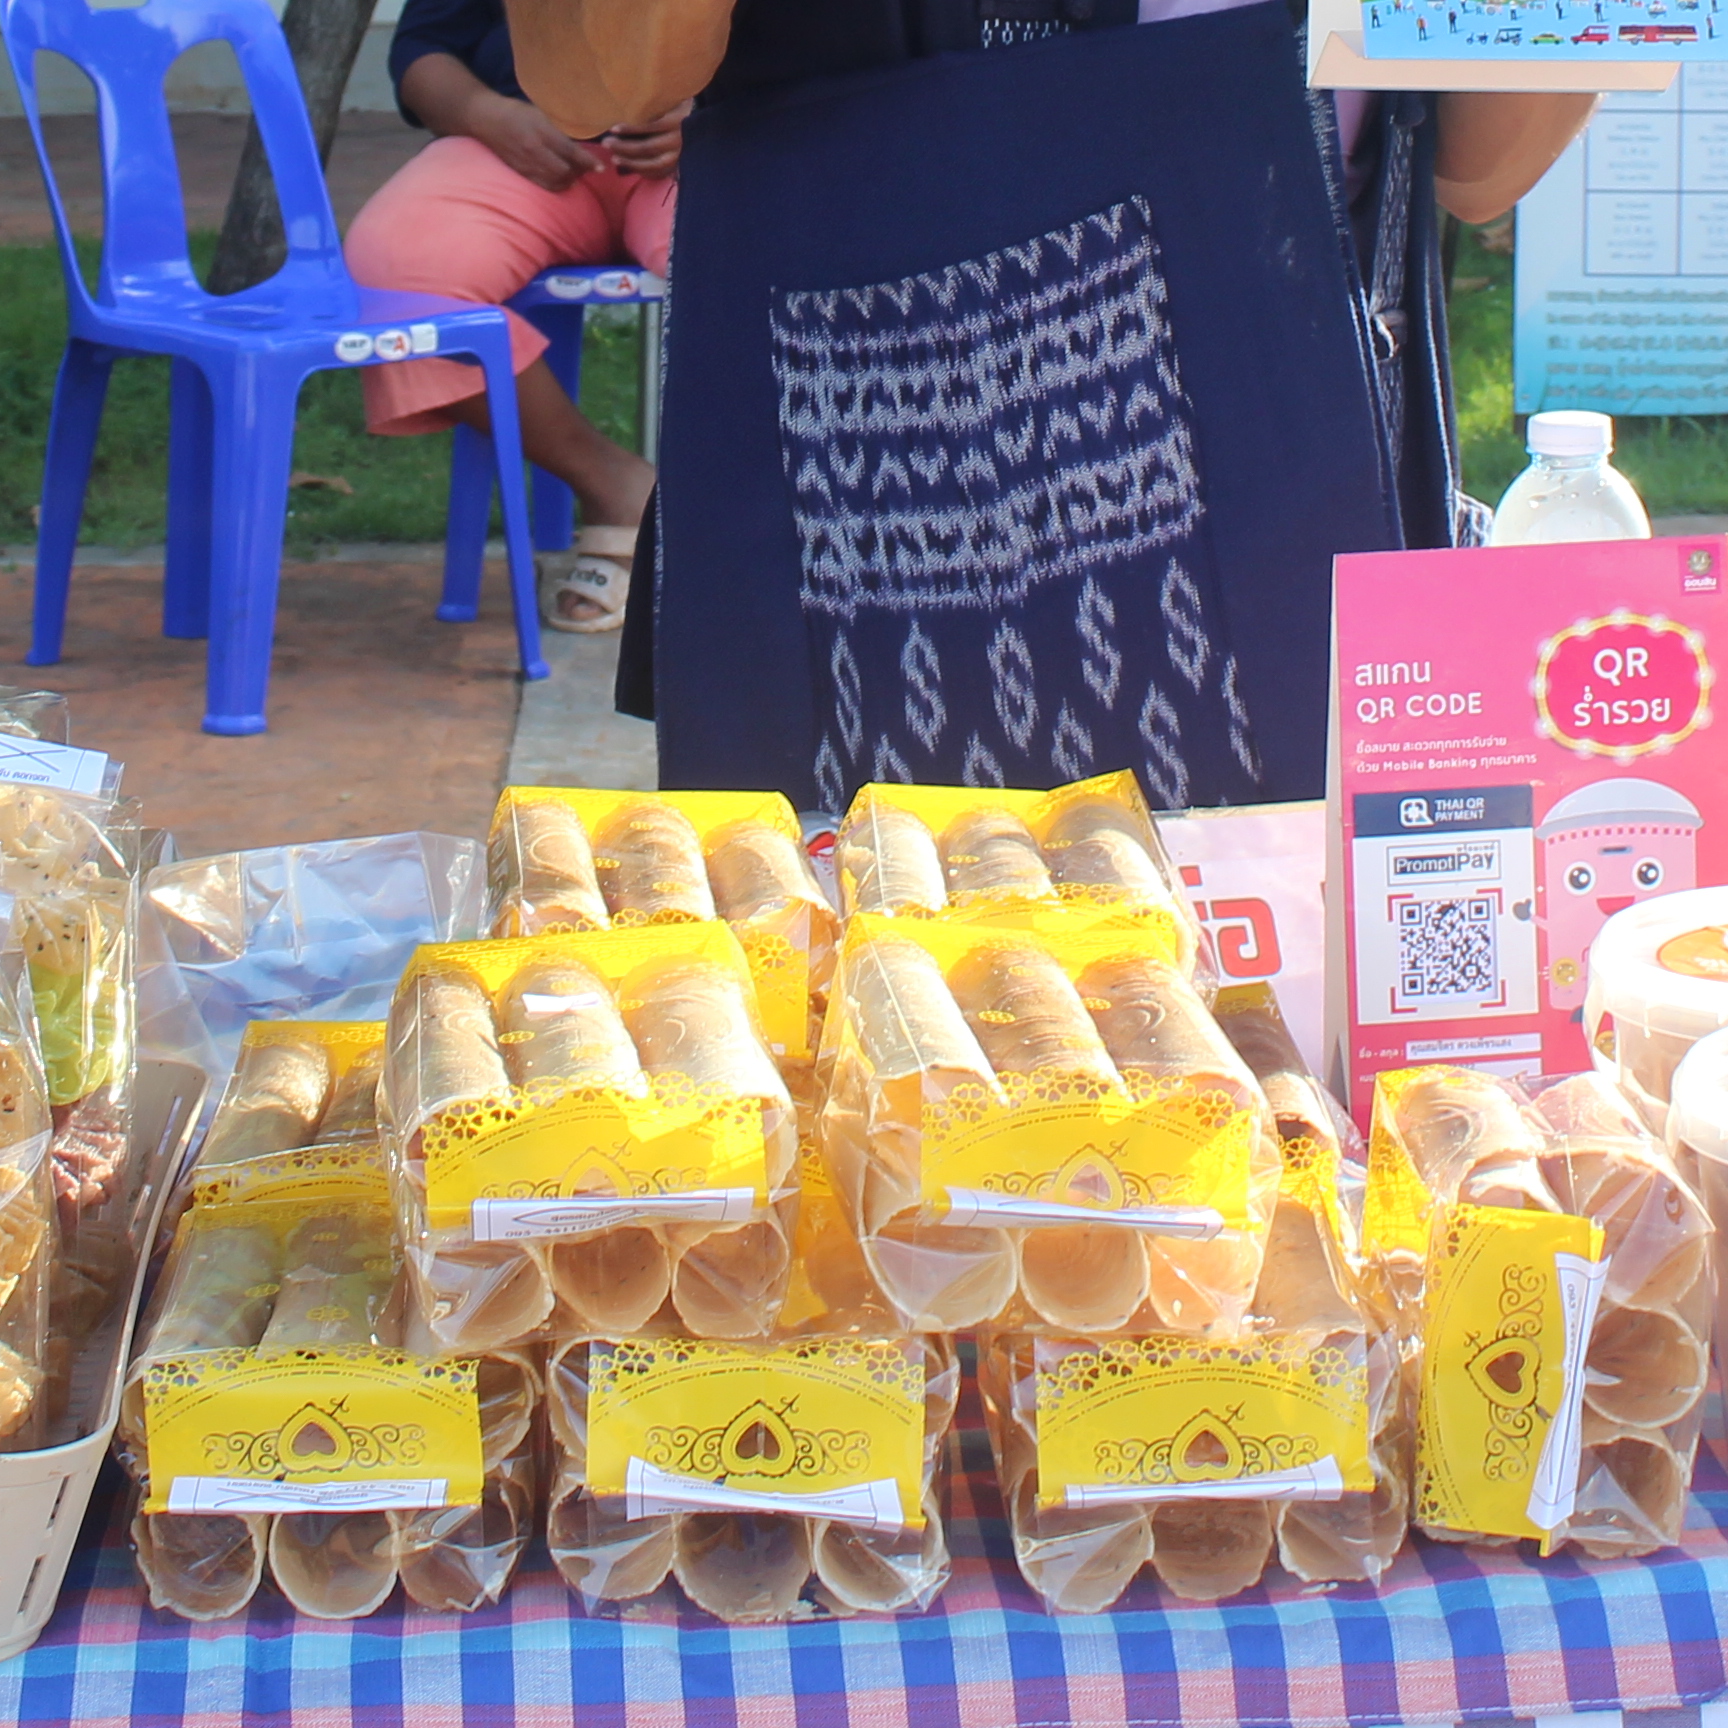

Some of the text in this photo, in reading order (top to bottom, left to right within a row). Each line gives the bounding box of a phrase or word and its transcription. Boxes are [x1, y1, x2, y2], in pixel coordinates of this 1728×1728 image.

[1354, 660, 1431, 686] สแกน
[1593, 647, 1650, 685] QR
[1356, 692, 1482, 724] QR CODE
[1573, 685, 1672, 727] ร่ำรวย
[1383, 759, 1424, 771] Mobile
[1428, 757, 1477, 769] Banking
[1434, 797, 1485, 811] THAI QR
[1435, 809, 1485, 822] PAYMENT
[1395, 852, 1494, 873] PromptPay
